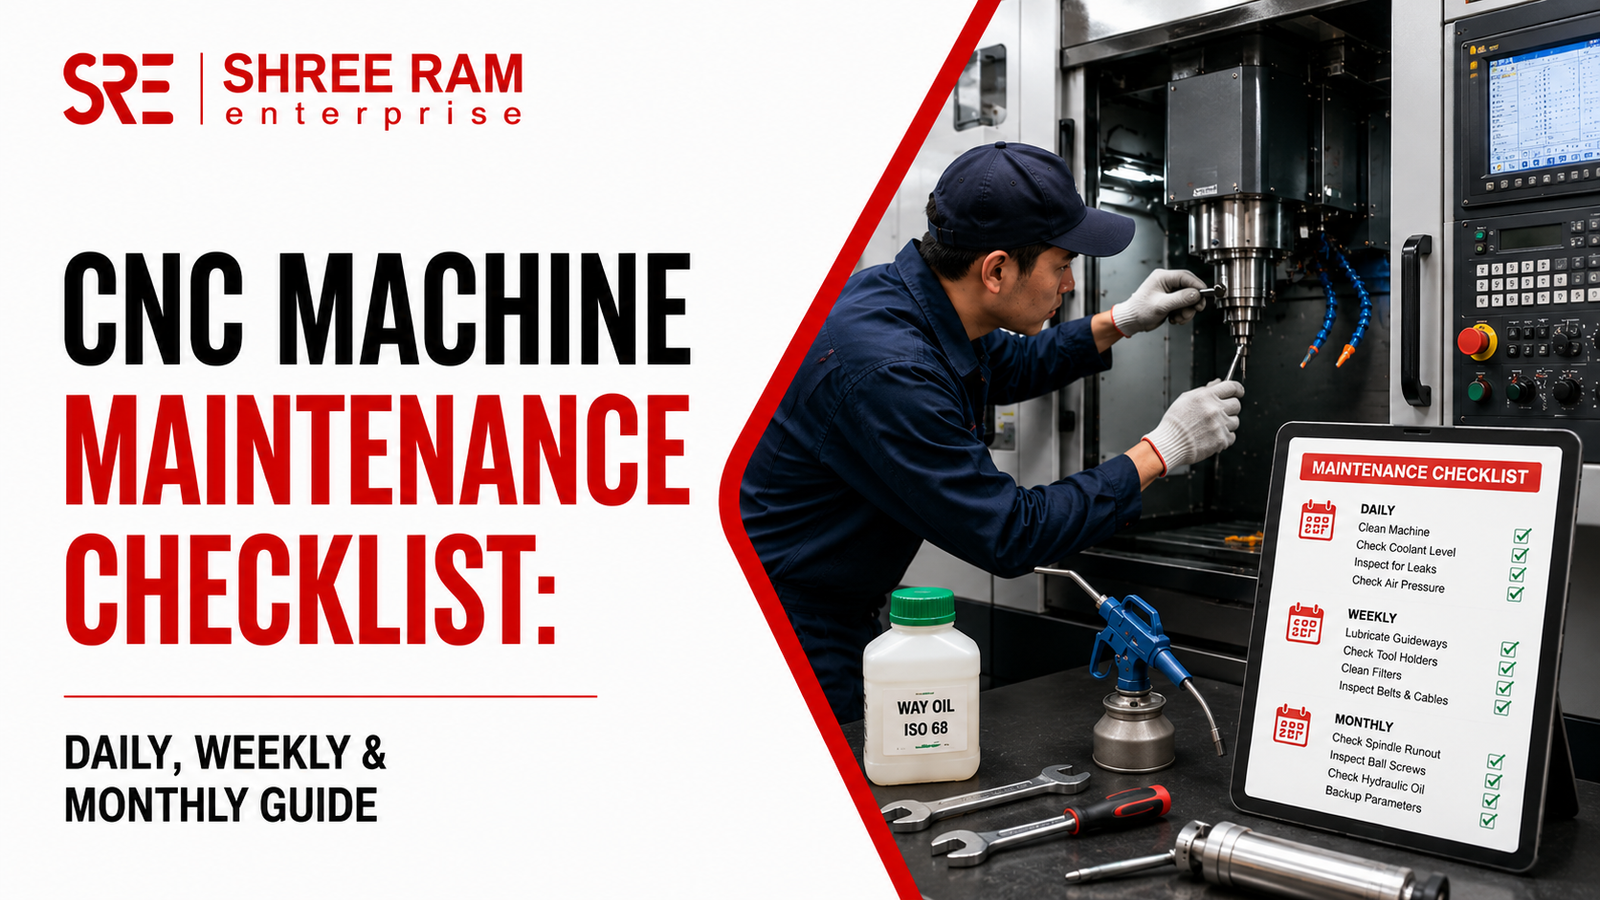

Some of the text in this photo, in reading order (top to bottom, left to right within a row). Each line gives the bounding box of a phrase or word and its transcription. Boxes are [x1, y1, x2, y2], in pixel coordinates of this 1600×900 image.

[1312, 461, 1529, 484] MAINTENANCE CHECKLIST
[1360, 503, 1396, 516] DAILY
[1358, 522, 1430, 537] Clean Machine
[1356, 539, 1456, 557] Check Coolant Level
[1354, 557, 1437, 574] Inspect for Leaks
[1352, 575, 1445, 594] Check Air Pressure
[1348, 608, 1397, 624] WEEKLY
[1345, 627, 1448, 650] Lubricate Guideways
[1343, 645, 1438, 667] Check Tool Holders
[1341, 663, 1402, 680] Clean Filters
[1339, 680, 1448, 706] Inspect Belts & Cables
[897, 699, 955, 715] WAY OIL
[904, 721, 949, 737] ISO 68
[1335, 713, 1394, 733] MONTHLY
[1332, 732, 1441, 759] Check Spindle Runout
[1330, 750, 1426, 776] Inspect Ball Screws
[1328, 768, 1425, 795] Check Hydraulic Oil
[1325, 785, 1422, 813] Backup Parameters
